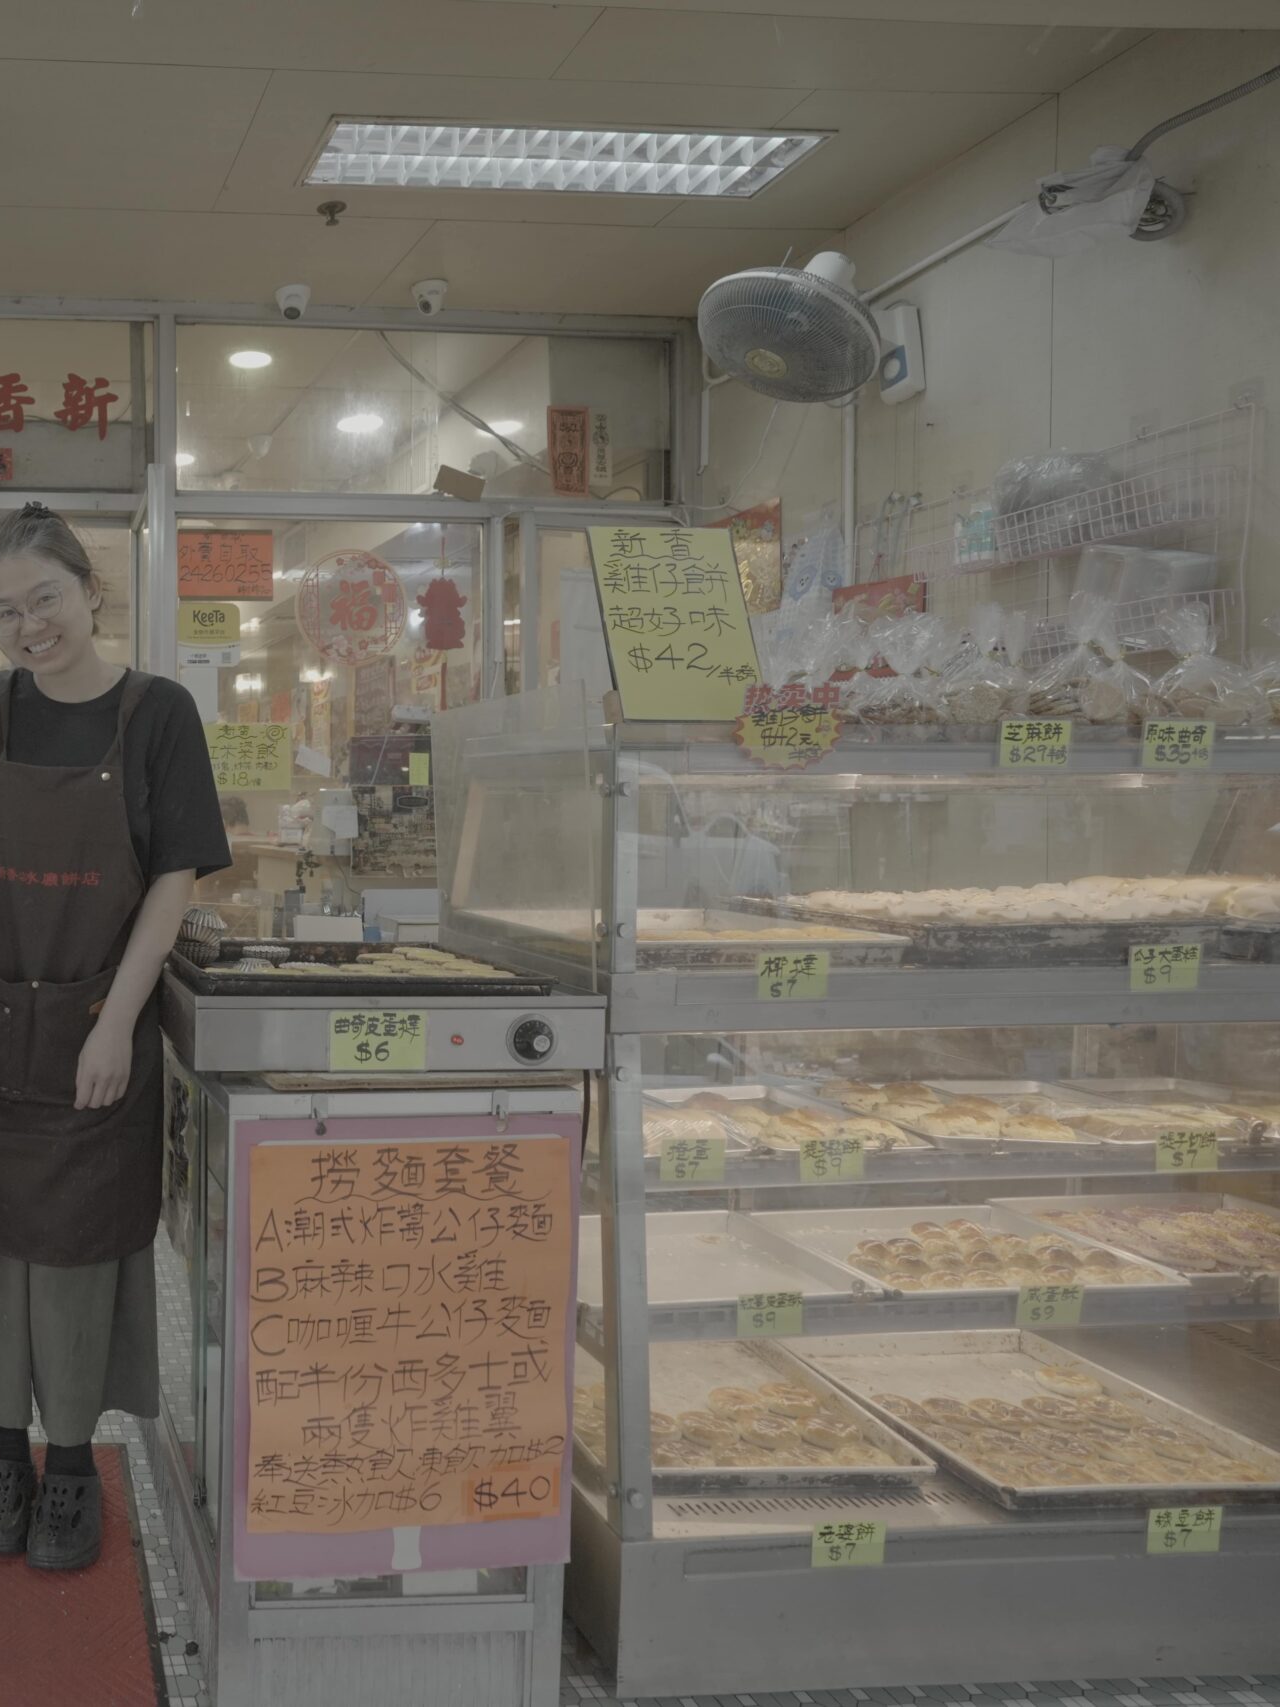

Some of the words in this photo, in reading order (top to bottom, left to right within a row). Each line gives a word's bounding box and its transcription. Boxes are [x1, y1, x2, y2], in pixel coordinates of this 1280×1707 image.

[179, 562, 273, 584] 24260255
[603, 560, 729, 602] 雞仔餅
[330, 580, 377, 632] 福
[609, 605, 737, 637] 超好味
[1004, 722, 1063, 744] 芝麻餅
[1146, 724, 1207, 744] 原味曲奇
[1144, 964, 1172, 984] $9
[770, 979, 797, 998] $7
[354, 1039, 390, 1064] $6
[812, 1156, 842, 1178] $9
[1171, 1149, 1198, 1168] $7
[311, 1144, 524, 1198] 撈麵套餐
[675, 1161, 700, 1179] $7
[752, 1311, 776, 1328] $9
[1030, 1304, 1055, 1321] $9
[255, 1344, 554, 1412] 配半份西多士或
[302, 1391, 521, 1450] 兩隻炸雞翼
[473, 1475, 551, 1508] $40
[1164, 1529, 1192, 1549] $7
[828, 1543, 857, 1561] $7
